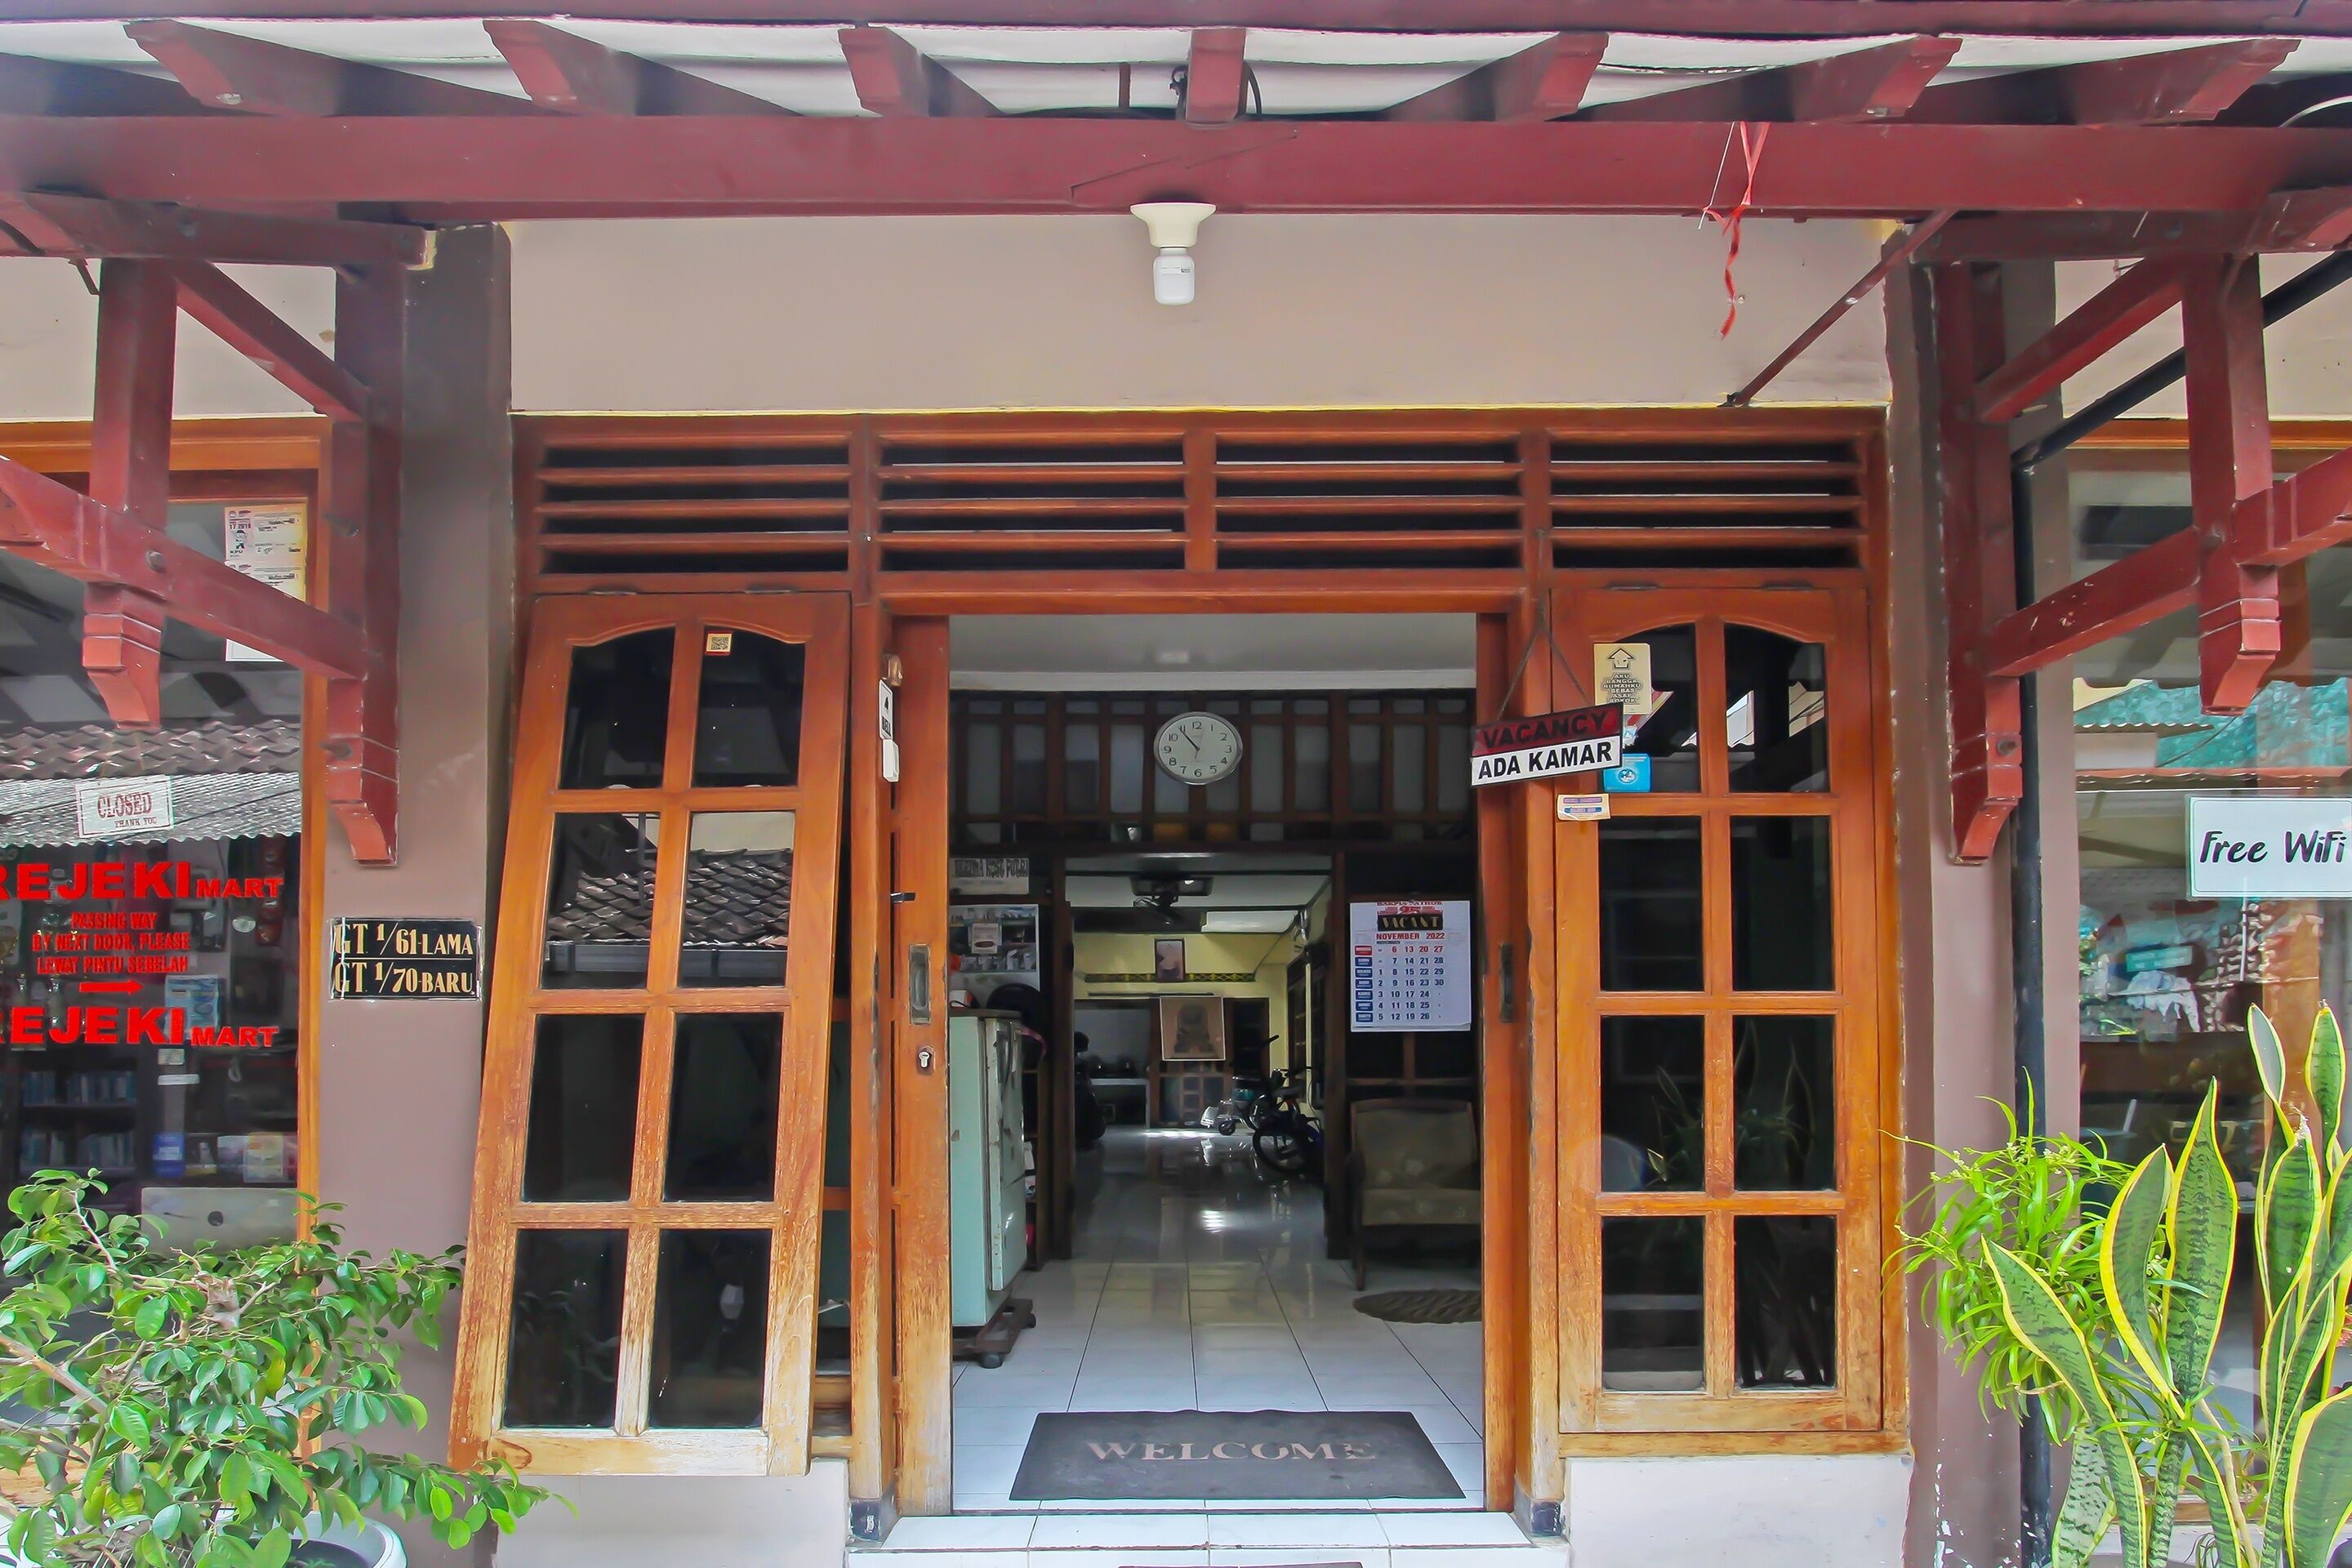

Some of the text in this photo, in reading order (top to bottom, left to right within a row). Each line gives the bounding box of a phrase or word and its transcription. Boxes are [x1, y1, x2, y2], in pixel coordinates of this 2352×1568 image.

[1192, 721, 1202, 729] 12
[1481, 710, 1608, 748] VACANCY
[1168, 733, 1178, 742] 10
[1220, 733, 1227, 742] 2
[1163, 746, 1172, 754] 9
[1225, 745, 1232, 753] 3
[1169, 757, 1177, 766] 8
[1477, 741, 1612, 780] ADA KAMAR
[1180, 766, 1187, 774] 7
[1194, 768, 1202, 777] 6
[1209, 765, 1217, 774] 5
[97, 791, 152, 819] CLOSED
[115, 817, 158, 828] THANK YOU
[2198, 829, 2347, 863] Free WiFi
[0, 862, 284, 900] EJEKI MART
[71, 911, 158, 929] PASSING WAY
[1382, 915, 1440, 929] VACANT
[32, 932, 190, 954] BY NEXT DOOR, PLEASE
[37, 956, 189, 974] LEWAT PINTU SEBELAH
[0, 1006, 280, 1047] EJEKI MART
[1085, 1441, 1379, 1461] WELCOME
